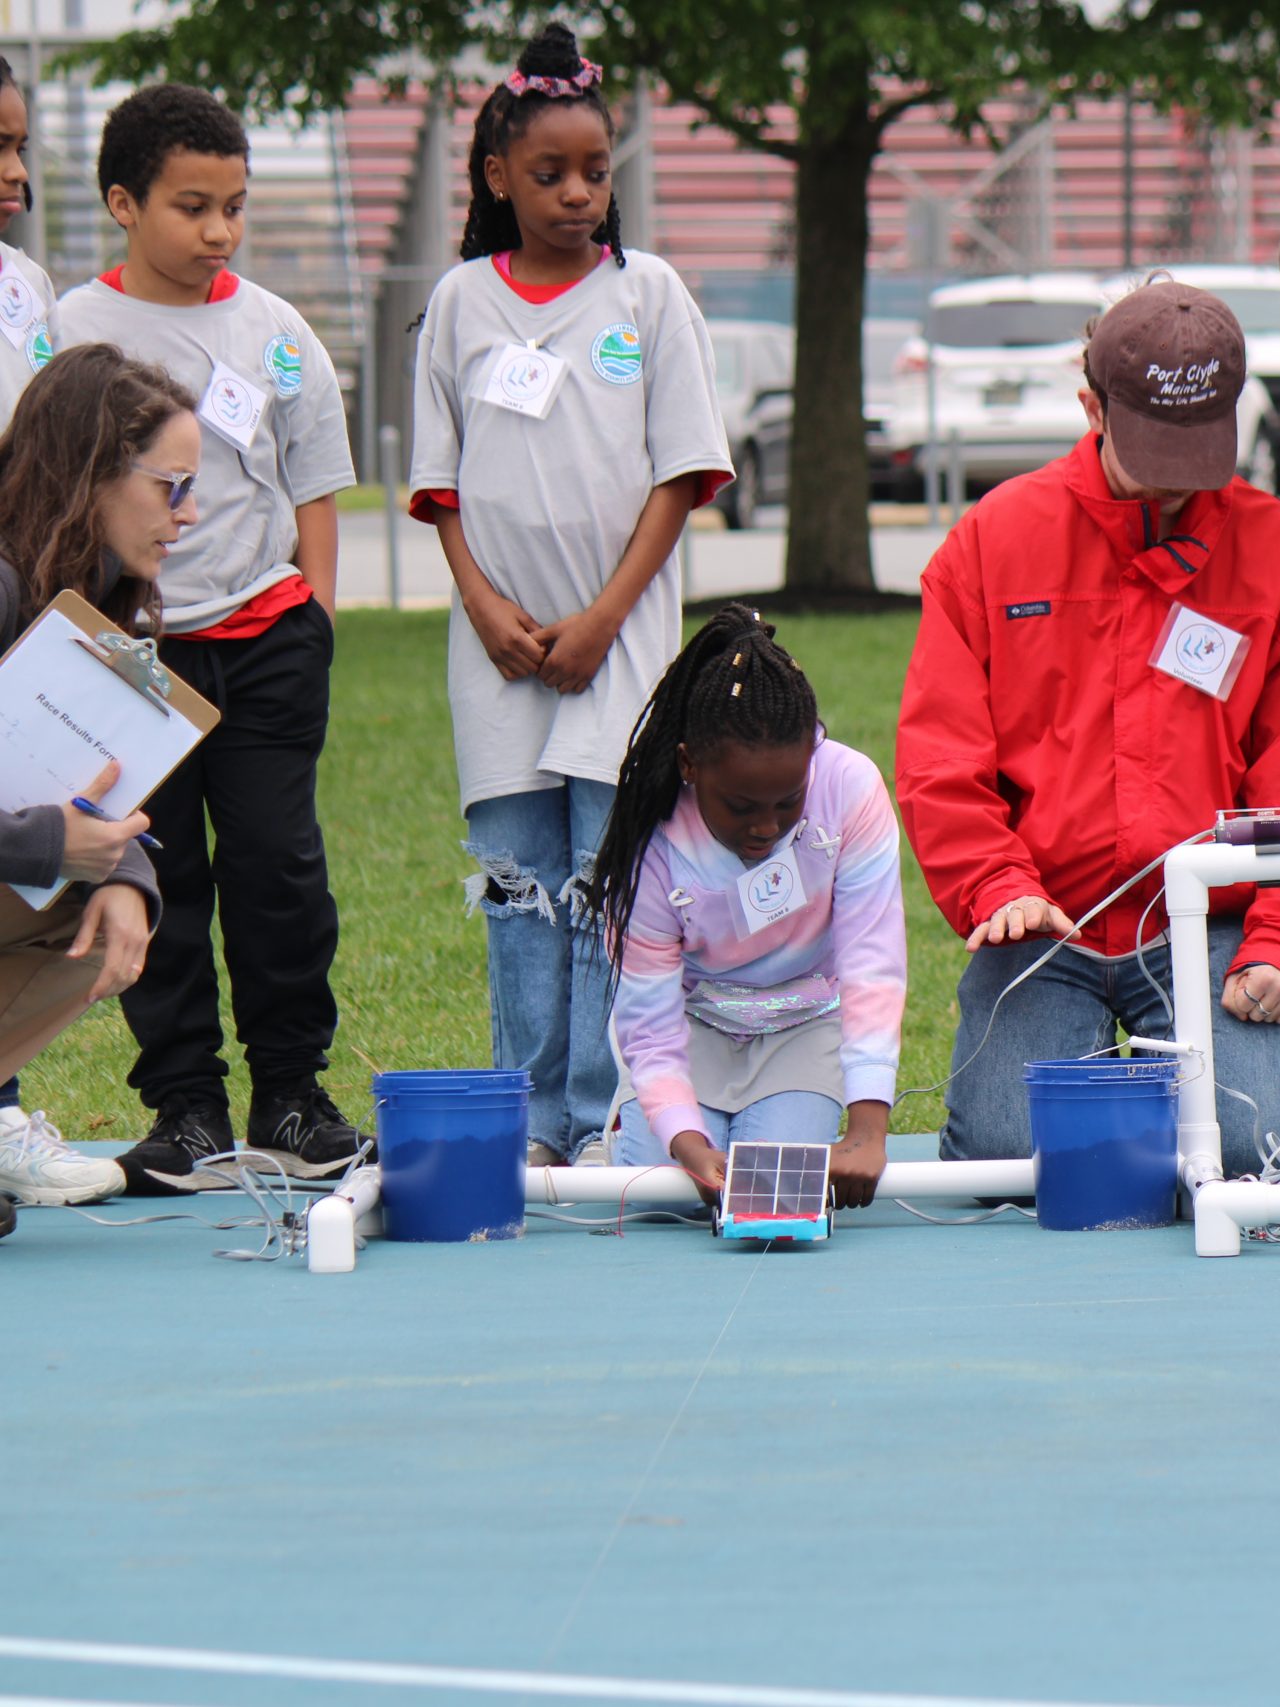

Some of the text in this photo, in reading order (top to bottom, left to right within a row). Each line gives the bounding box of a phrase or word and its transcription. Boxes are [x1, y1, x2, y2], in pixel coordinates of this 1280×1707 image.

[1146, 357, 1220, 384] Port Clyde
[1160, 382, 1198, 396] Maine
[36, 693, 60, 716] Race
[59, 712, 94, 744] Results
[767, 909, 785, 922] TEAM
